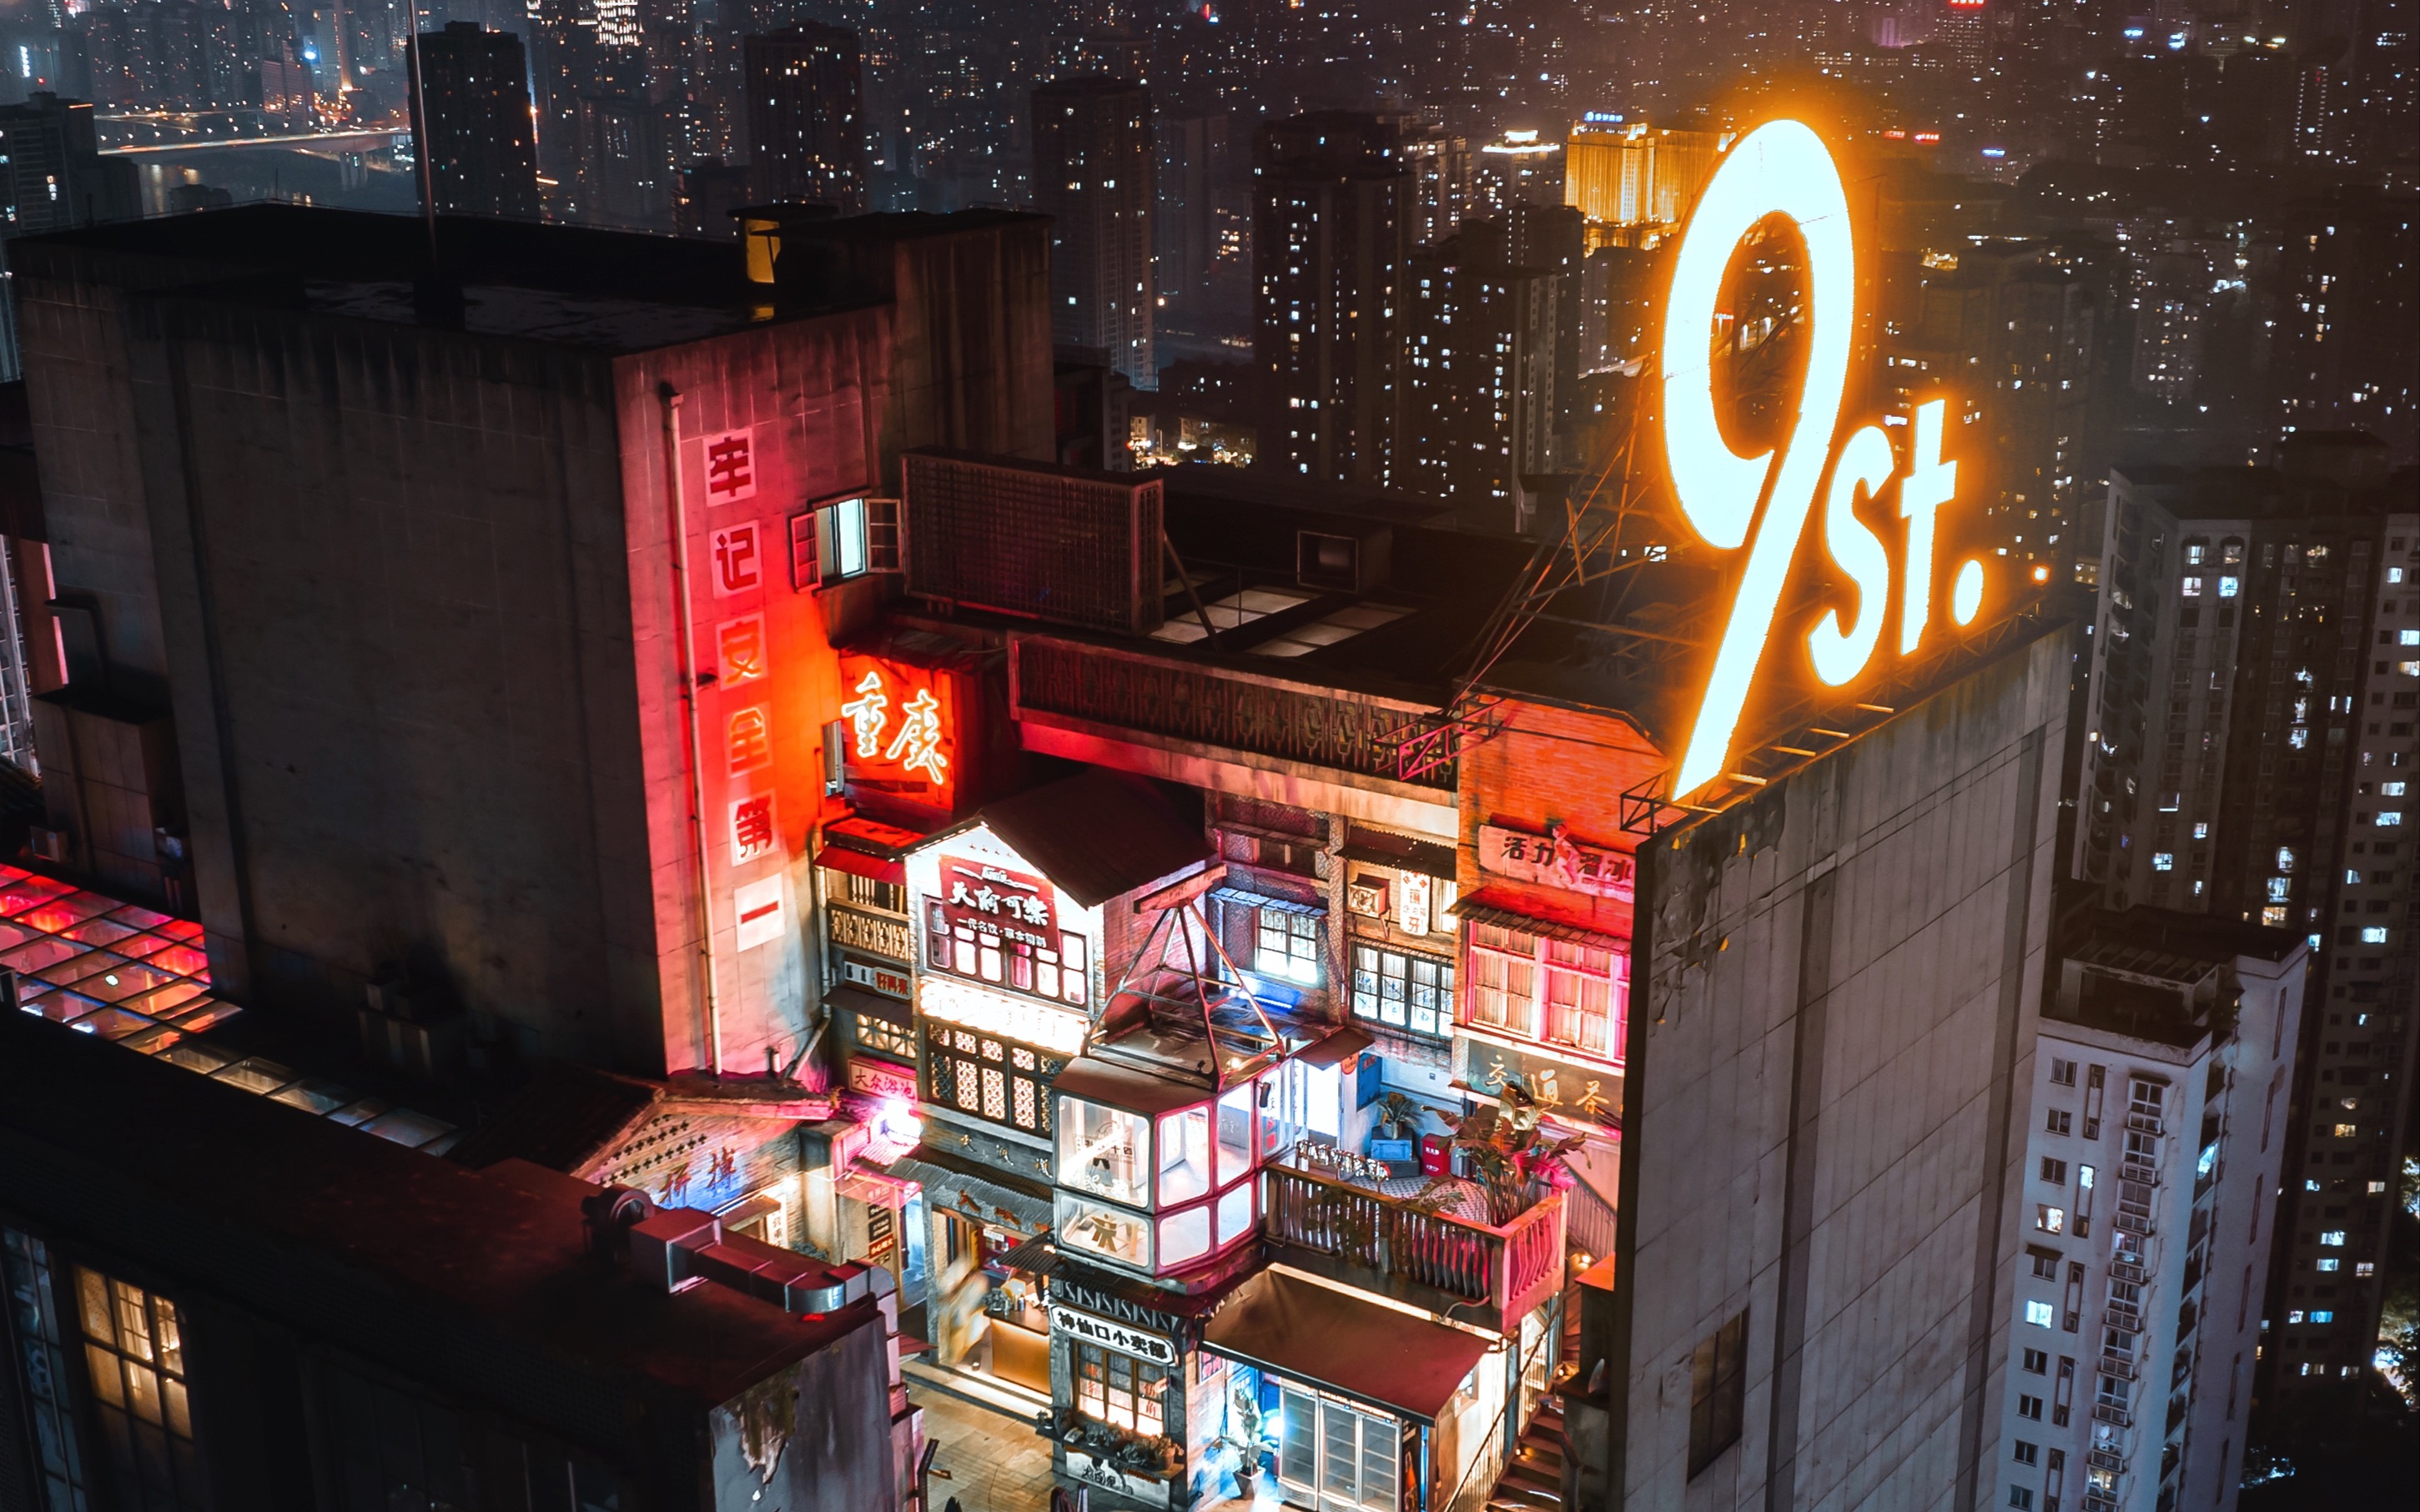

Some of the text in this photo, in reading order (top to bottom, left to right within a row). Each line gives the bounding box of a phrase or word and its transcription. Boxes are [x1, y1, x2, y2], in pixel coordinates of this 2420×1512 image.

[854, 1068, 916, 1101] 大众浴池
[1486, 1054, 1623, 1116] 交通茶
[1058, 1310, 1168, 1360] 神仙口小卖部
